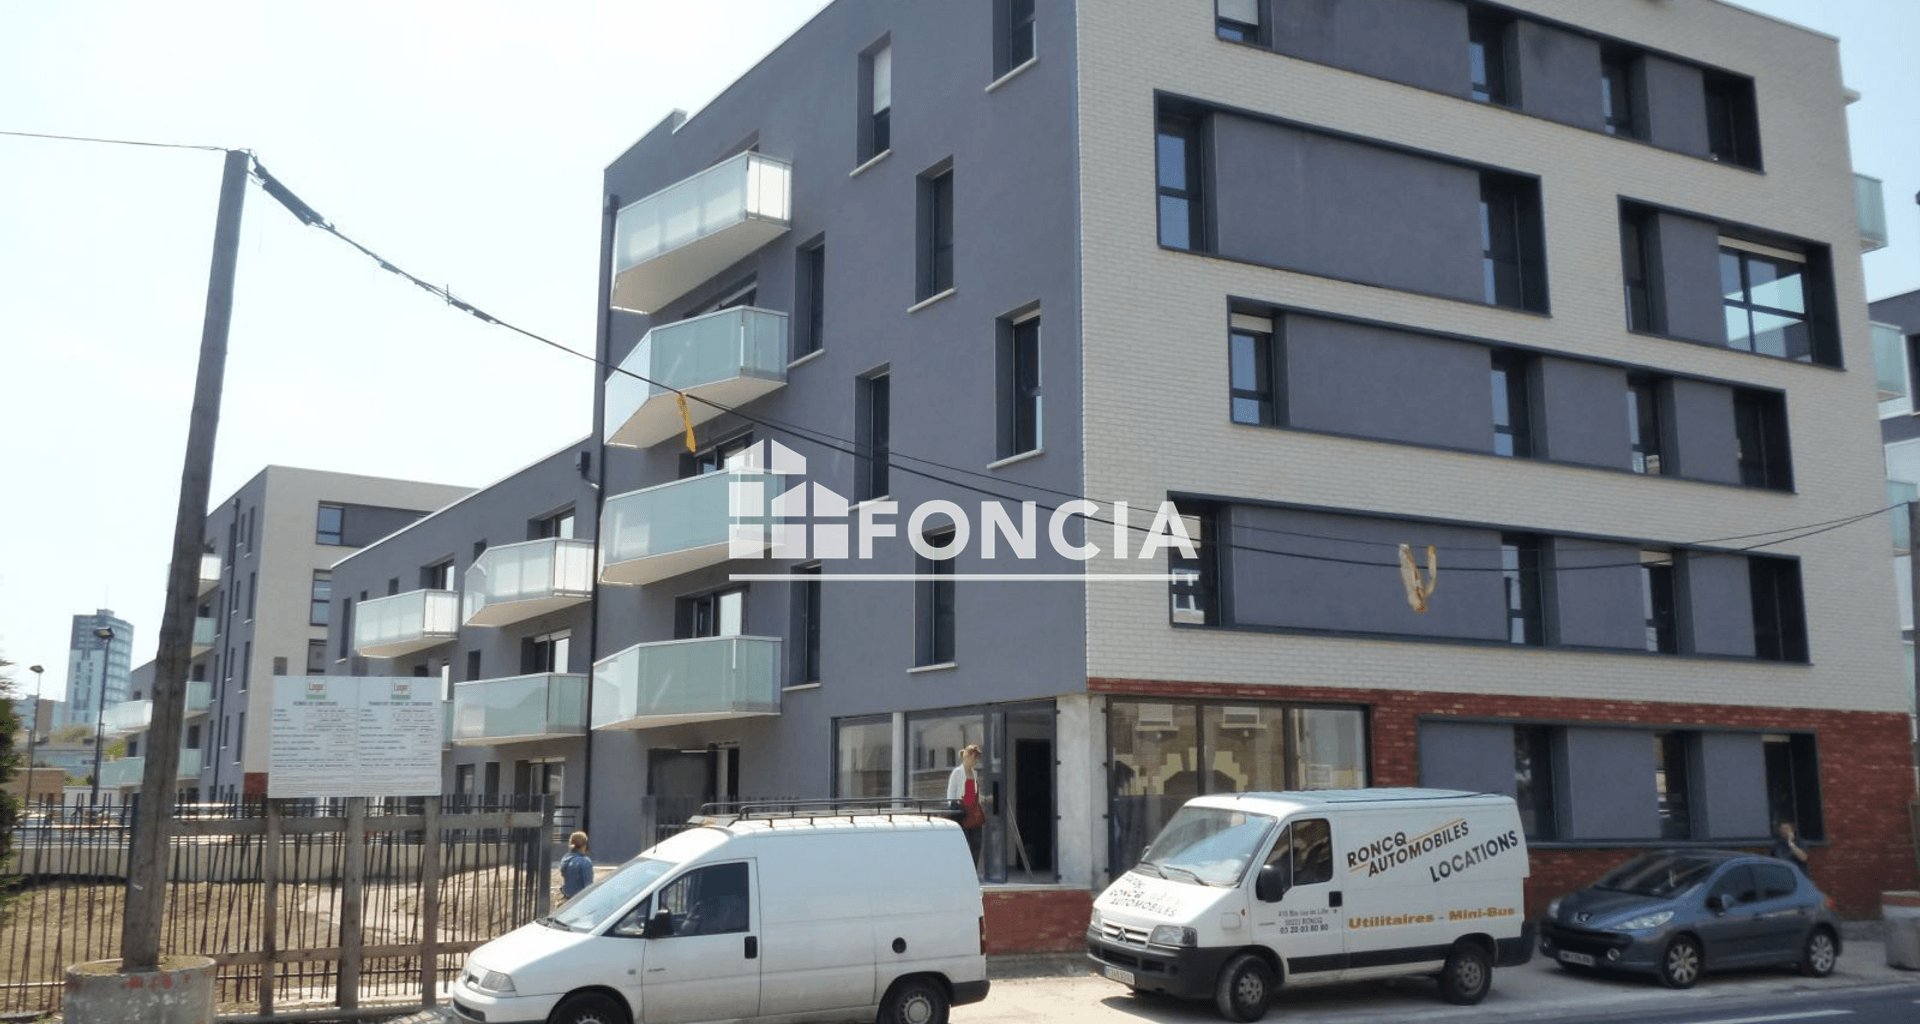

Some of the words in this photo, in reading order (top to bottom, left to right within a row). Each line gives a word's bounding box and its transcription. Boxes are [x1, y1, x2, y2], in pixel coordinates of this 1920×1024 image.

[1347, 831, 1407, 868] RONCQ
[1368, 821, 1469, 877] AUTOMOBILES
[1429, 830, 1518, 883] LOCATIONS
[1349, 913, 1435, 929] Utilitaires
[1449, 906, 1516, 921] Mini-Bus
